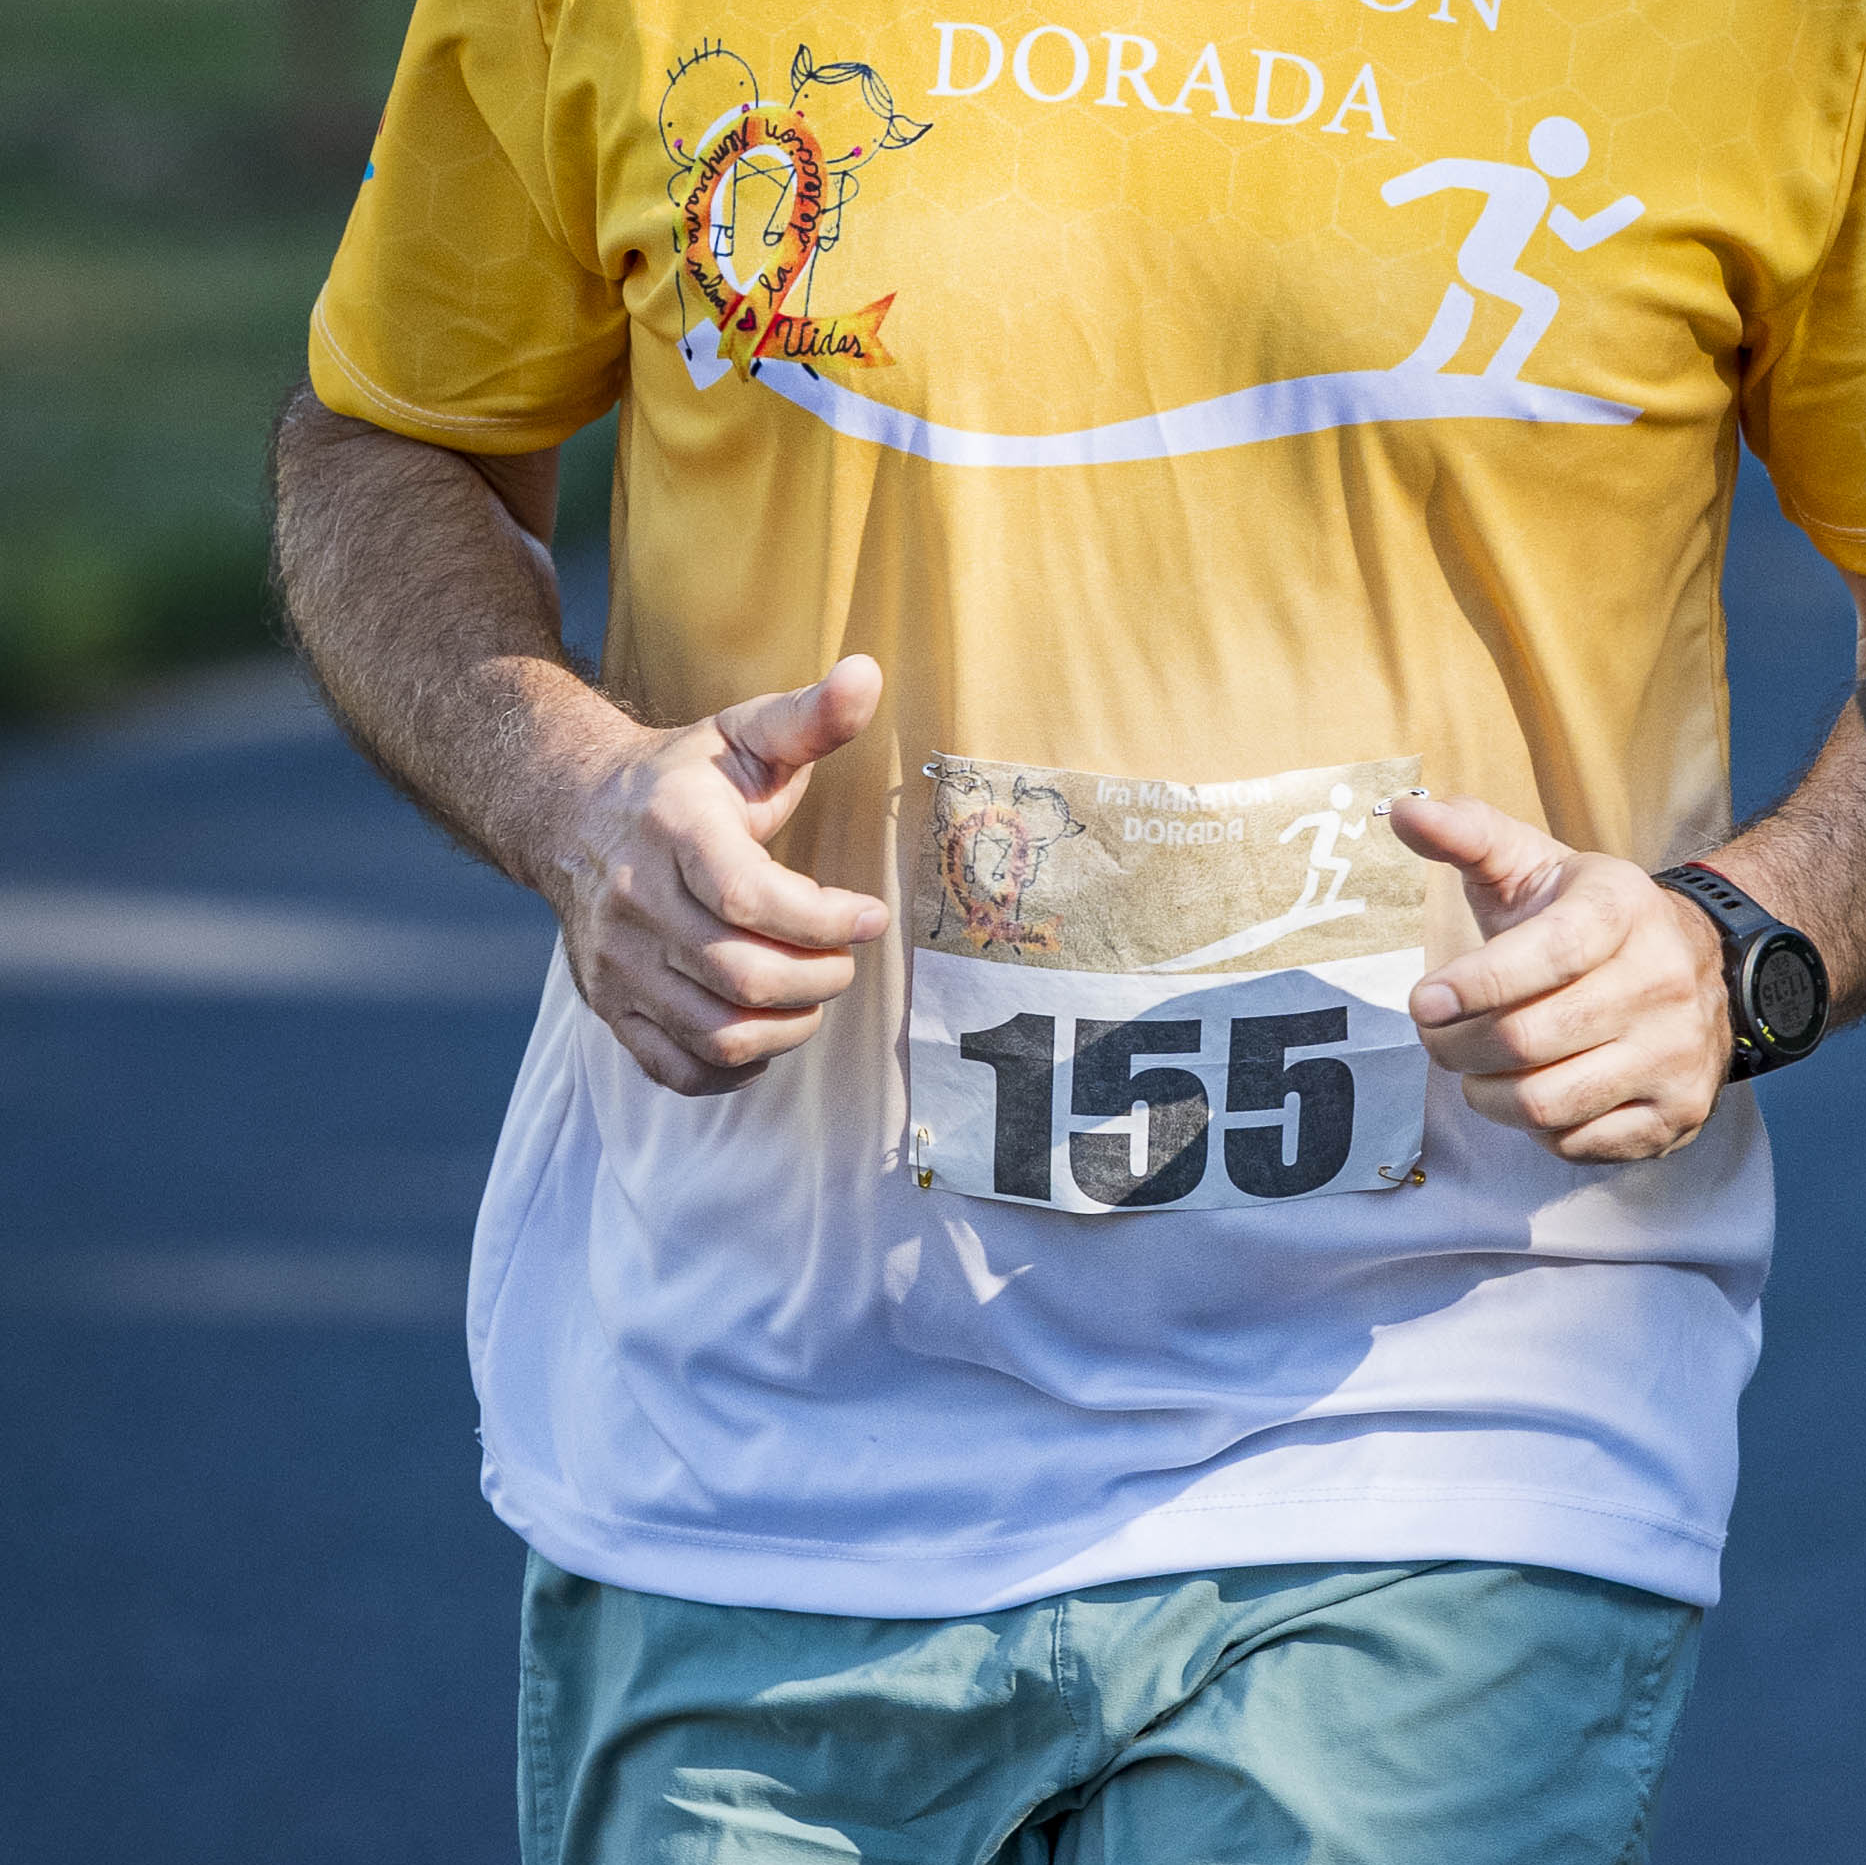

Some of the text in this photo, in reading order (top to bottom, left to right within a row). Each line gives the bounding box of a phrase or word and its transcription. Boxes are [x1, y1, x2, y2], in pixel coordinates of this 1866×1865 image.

[927, 23, 1396, 141] DORADA
[775, 318, 865, 358] Vidas
[1122, 816, 1245, 845] DORADA
[960, 1006, 1355, 1207] 155
